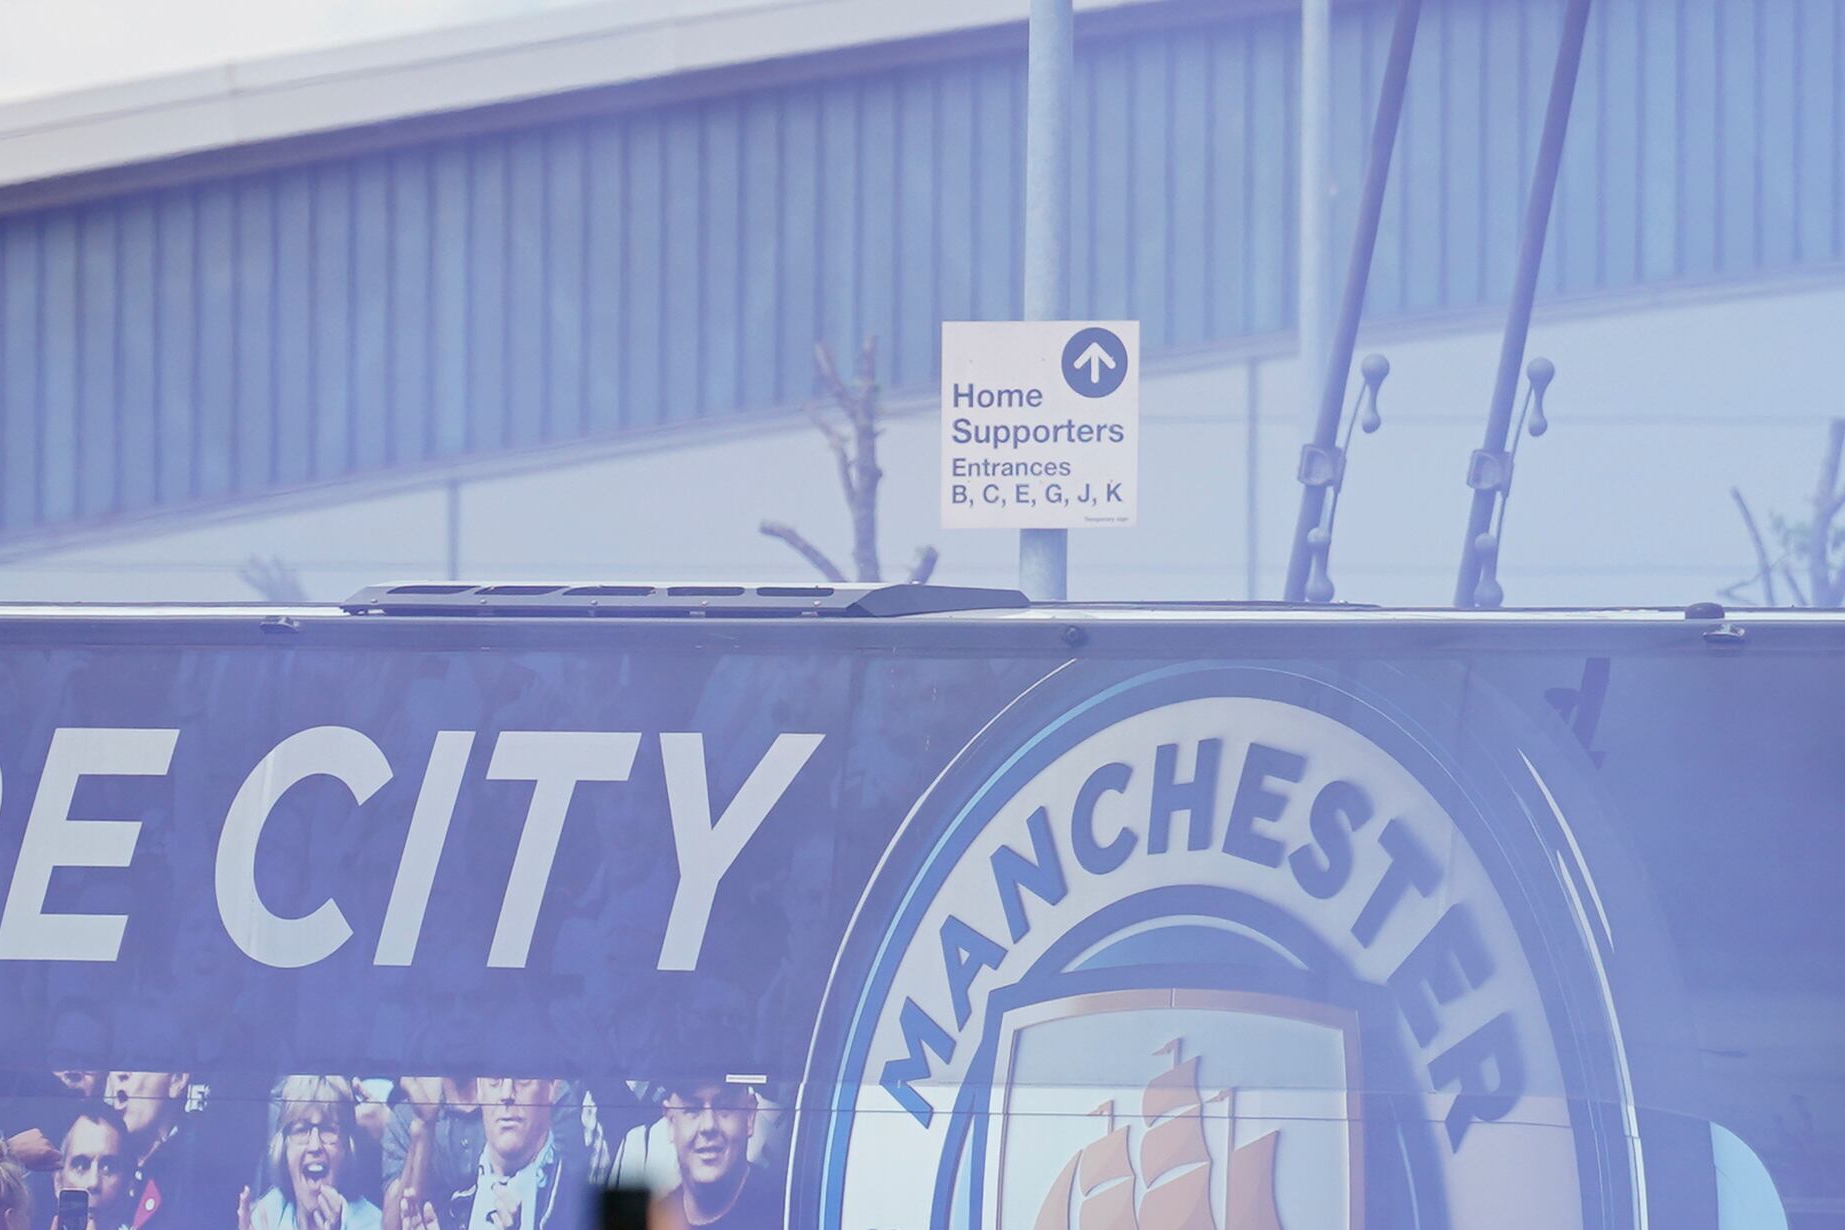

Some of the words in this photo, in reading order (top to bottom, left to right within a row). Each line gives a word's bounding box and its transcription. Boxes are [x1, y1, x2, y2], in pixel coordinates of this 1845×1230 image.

[952, 383, 1043, 408] Home
[951, 418, 1125, 449] Supporters
[951, 457, 1071, 477] Entrances
[951, 484, 974, 508] B,
[982, 484, 1006, 507] C,
[1015, 484, 1037, 507] E,
[1045, 484, 1069, 507] G,
[1077, 483, 1097, 506] J,
[1106, 483, 1123, 502] K
[214, 725, 827, 971] CITY
[879, 737, 1527, 1153] MANCHESTER
